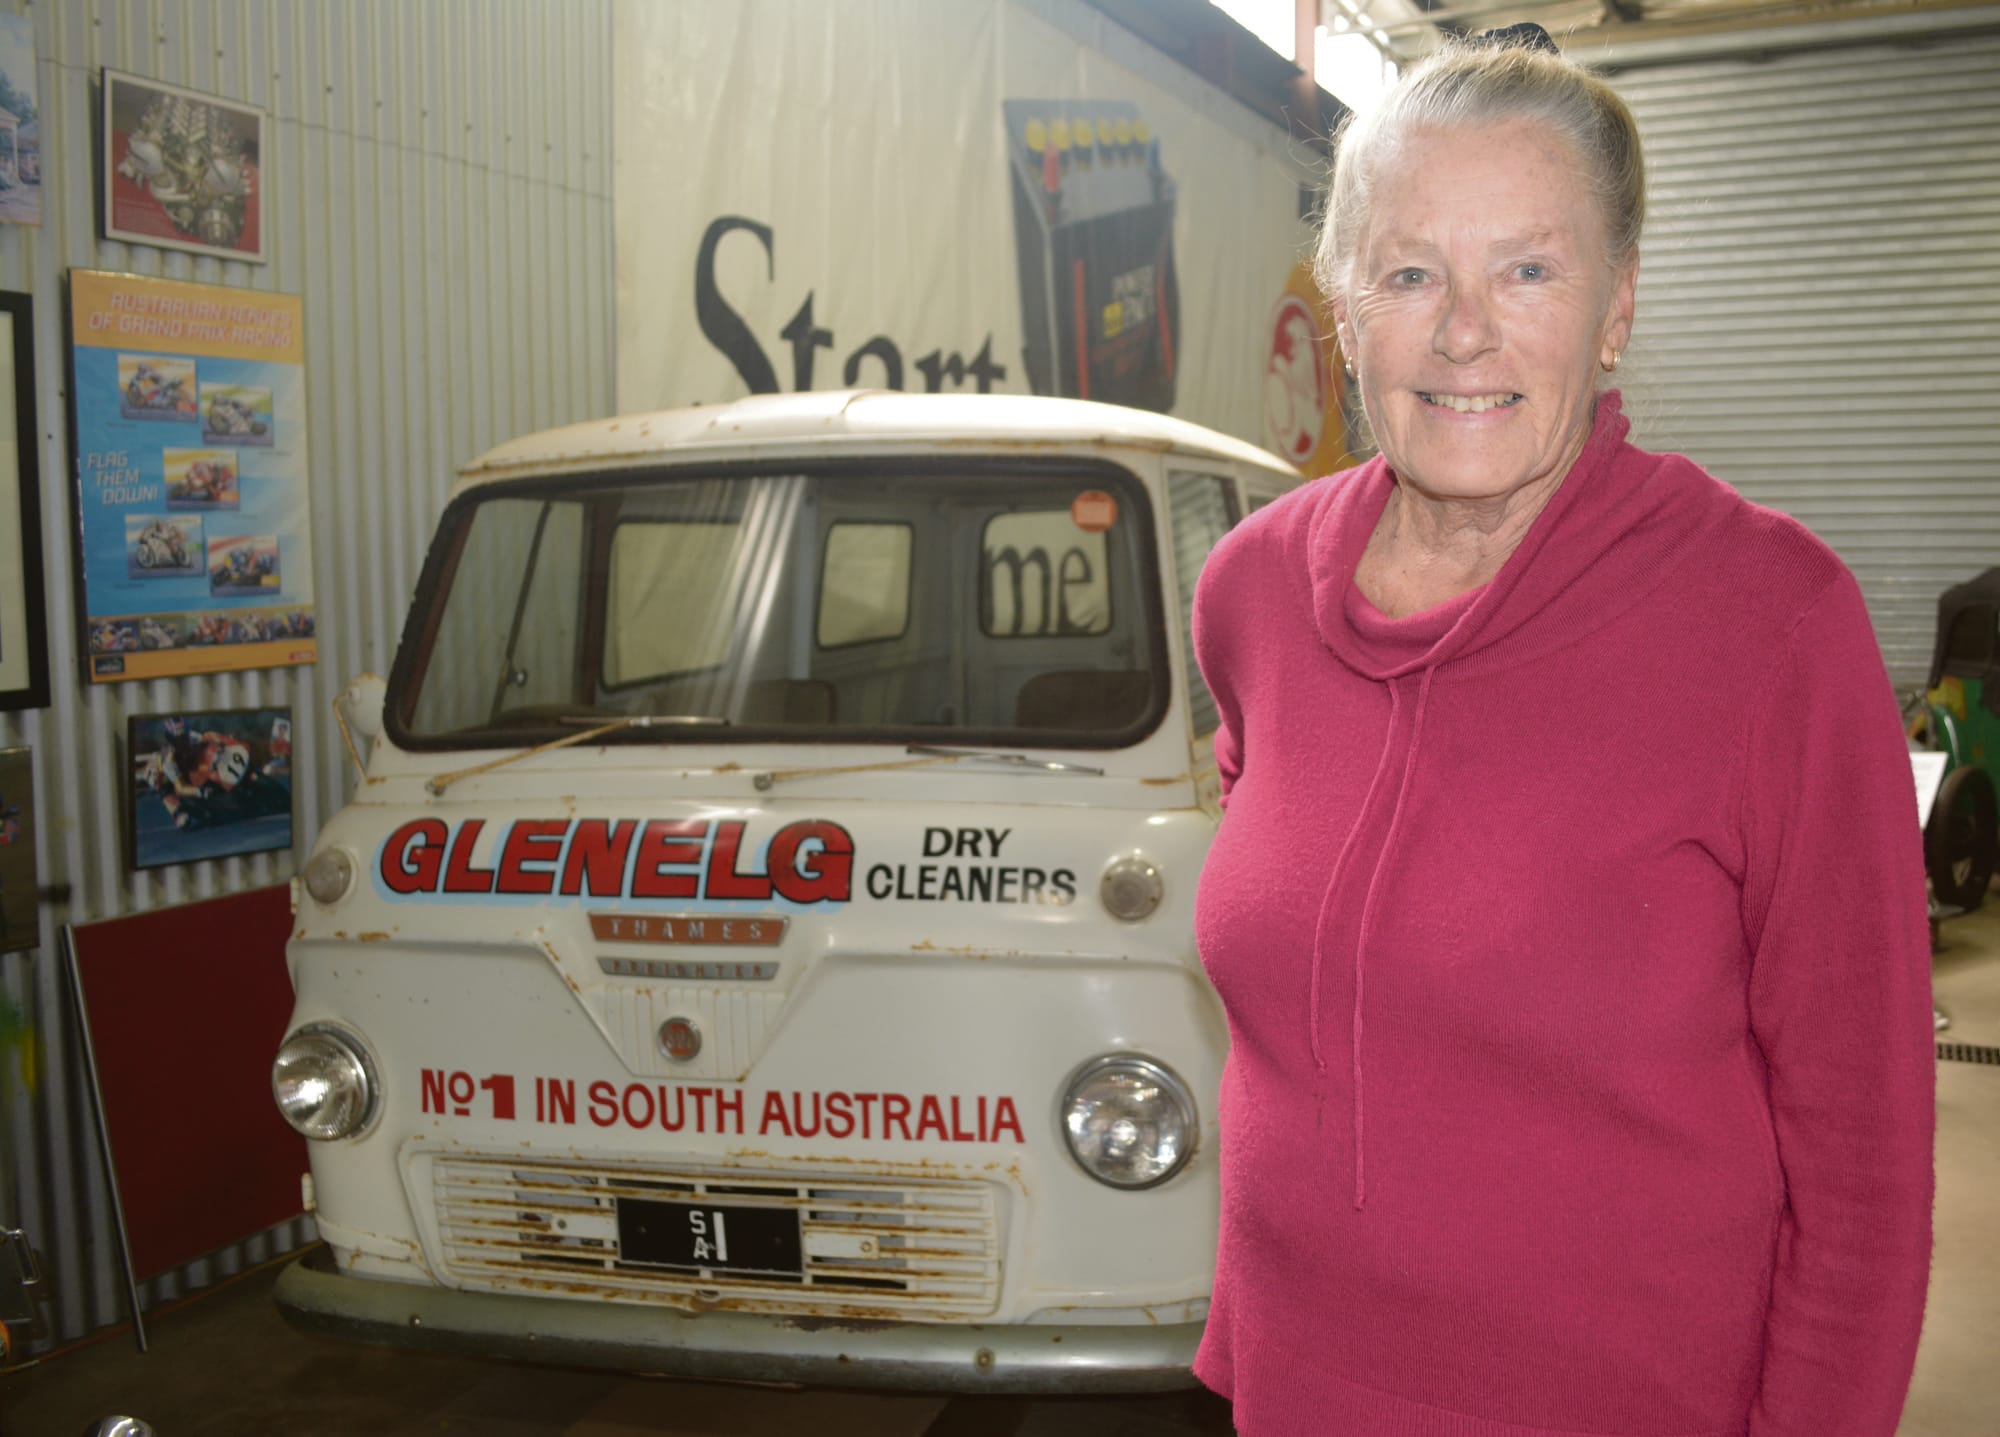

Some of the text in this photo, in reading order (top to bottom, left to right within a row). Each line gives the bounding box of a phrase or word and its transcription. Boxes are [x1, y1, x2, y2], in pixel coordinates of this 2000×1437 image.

[110, 292, 222, 321] AUSTRALIAN
[88, 311, 293, 348] OF GRAND PRIX RACING
[87, 450, 128, 469] FLAG
[95, 469, 140, 487] THEM
[102, 485, 158, 506] DOWN!
[227, 751, 245, 778] 19
[922, 827, 1012, 858] DRY
[378, 817, 856, 906] GLENELG
[866, 863, 1077, 906] CLEANERS
[610, 918, 763, 940] THAMES
[535, 1077, 576, 1125] IN
[588, 1080, 744, 1134] SOUTH
[758, 1091, 1026, 1143] AUSTRALIA
